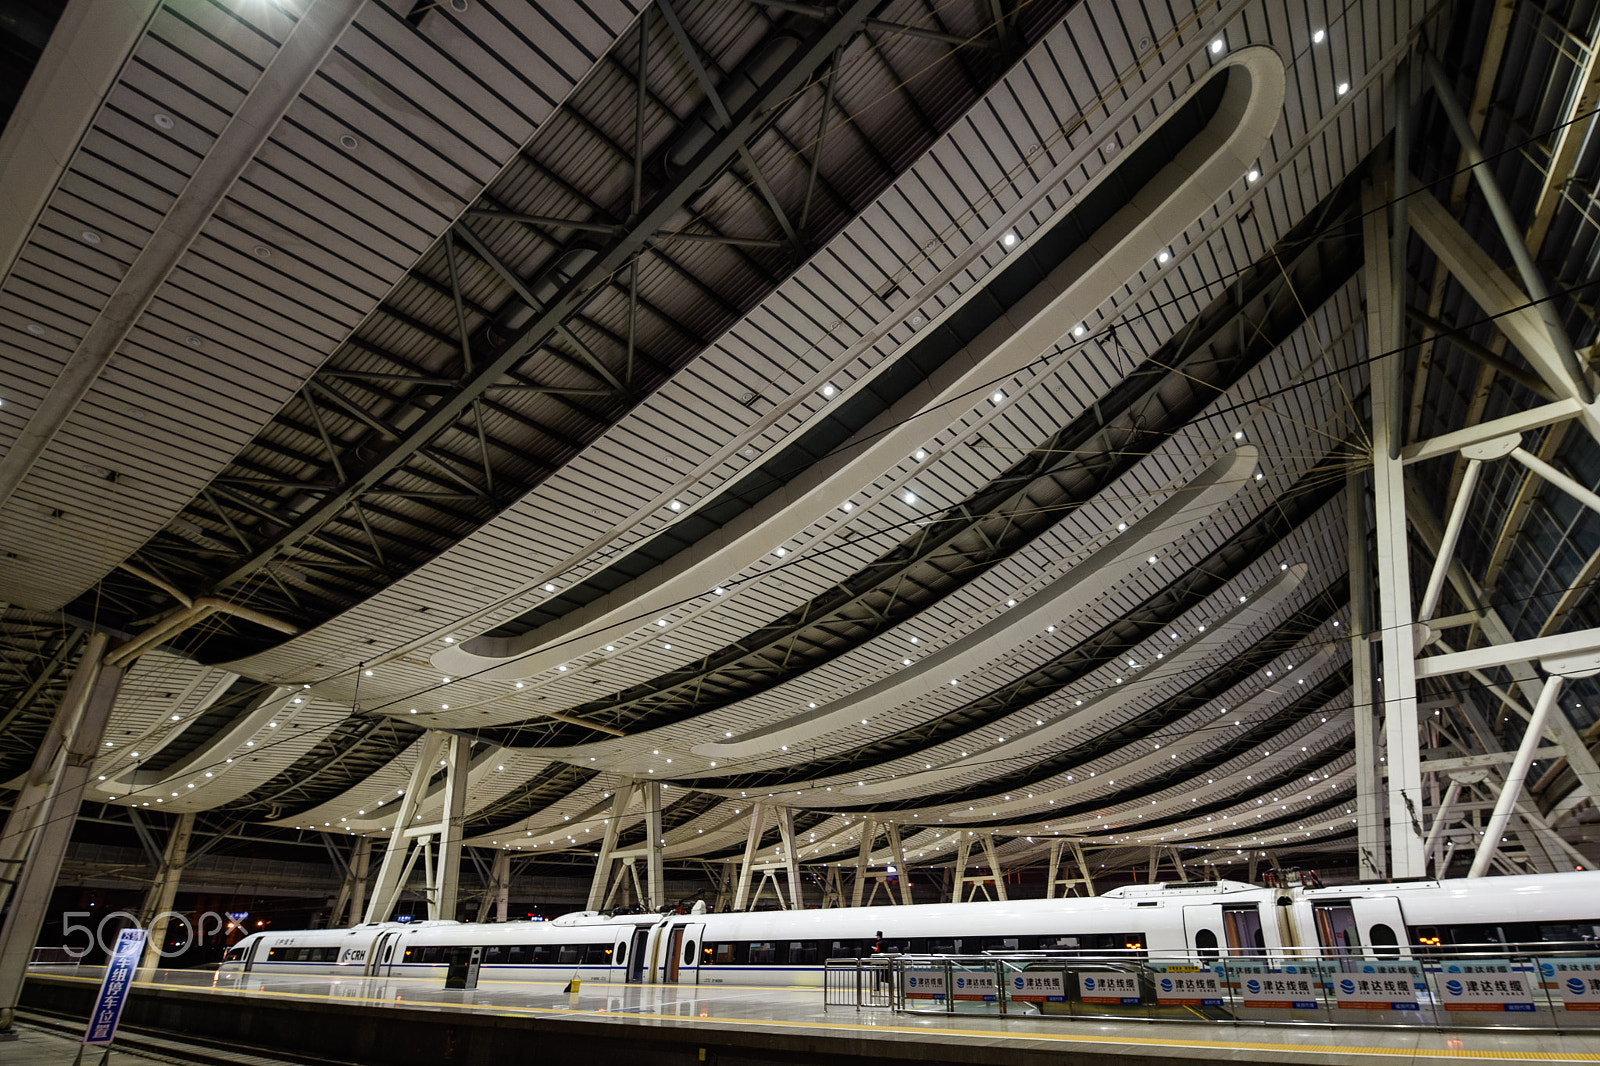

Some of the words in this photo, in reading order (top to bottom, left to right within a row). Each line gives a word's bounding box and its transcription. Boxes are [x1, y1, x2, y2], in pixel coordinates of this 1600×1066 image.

[350, 950, 366, 961] CRH
[1026, 978, 1060, 987] 津达线缆
[1097, 979, 1135, 988] 津达线缆
[1175, 979, 1217, 989] 津达线缆
[1263, 980, 1310, 991] 津达线缆
[1358, 980, 1409, 992] 津达线缆
[1465, 980, 1524, 992] 津达线缆
